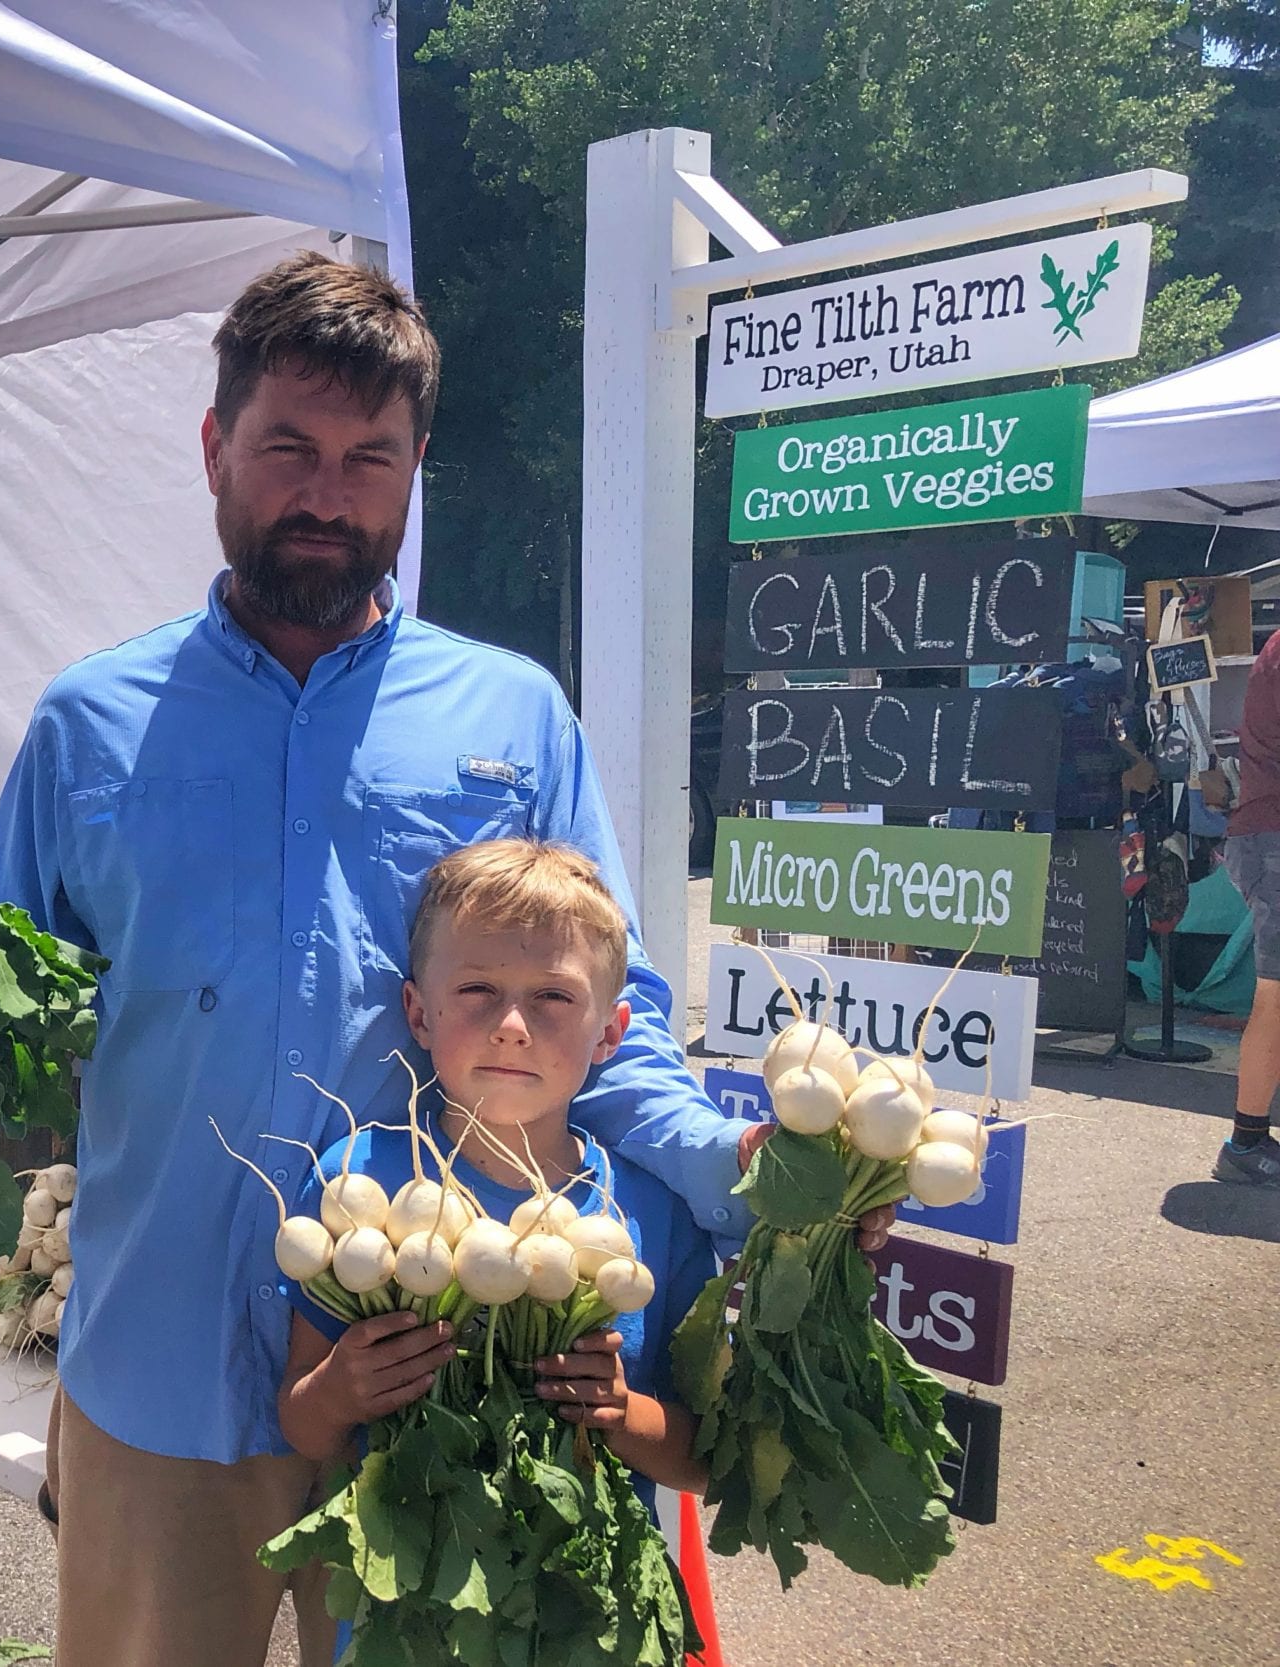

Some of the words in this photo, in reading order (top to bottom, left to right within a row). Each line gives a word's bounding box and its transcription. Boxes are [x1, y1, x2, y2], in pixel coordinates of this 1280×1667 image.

[723, 311, 801, 366] Fine
[811, 285, 899, 350] Tilth
[909, 272, 1026, 334] Farm
[761, 359, 879, 392] Draper,
[888, 334, 972, 374] Utah
[777, 412, 1019, 474] Organically
[743, 484, 870, 522] Grown
[882, 460, 1055, 510] Veggies
[748, 559, 1044, 660] GARLIC
[746, 696, 1032, 796] BASIL
[725, 840, 840, 913] Micro
[849, 847, 1013, 926] Greens
[724, 968, 995, 1068] Lettuce
